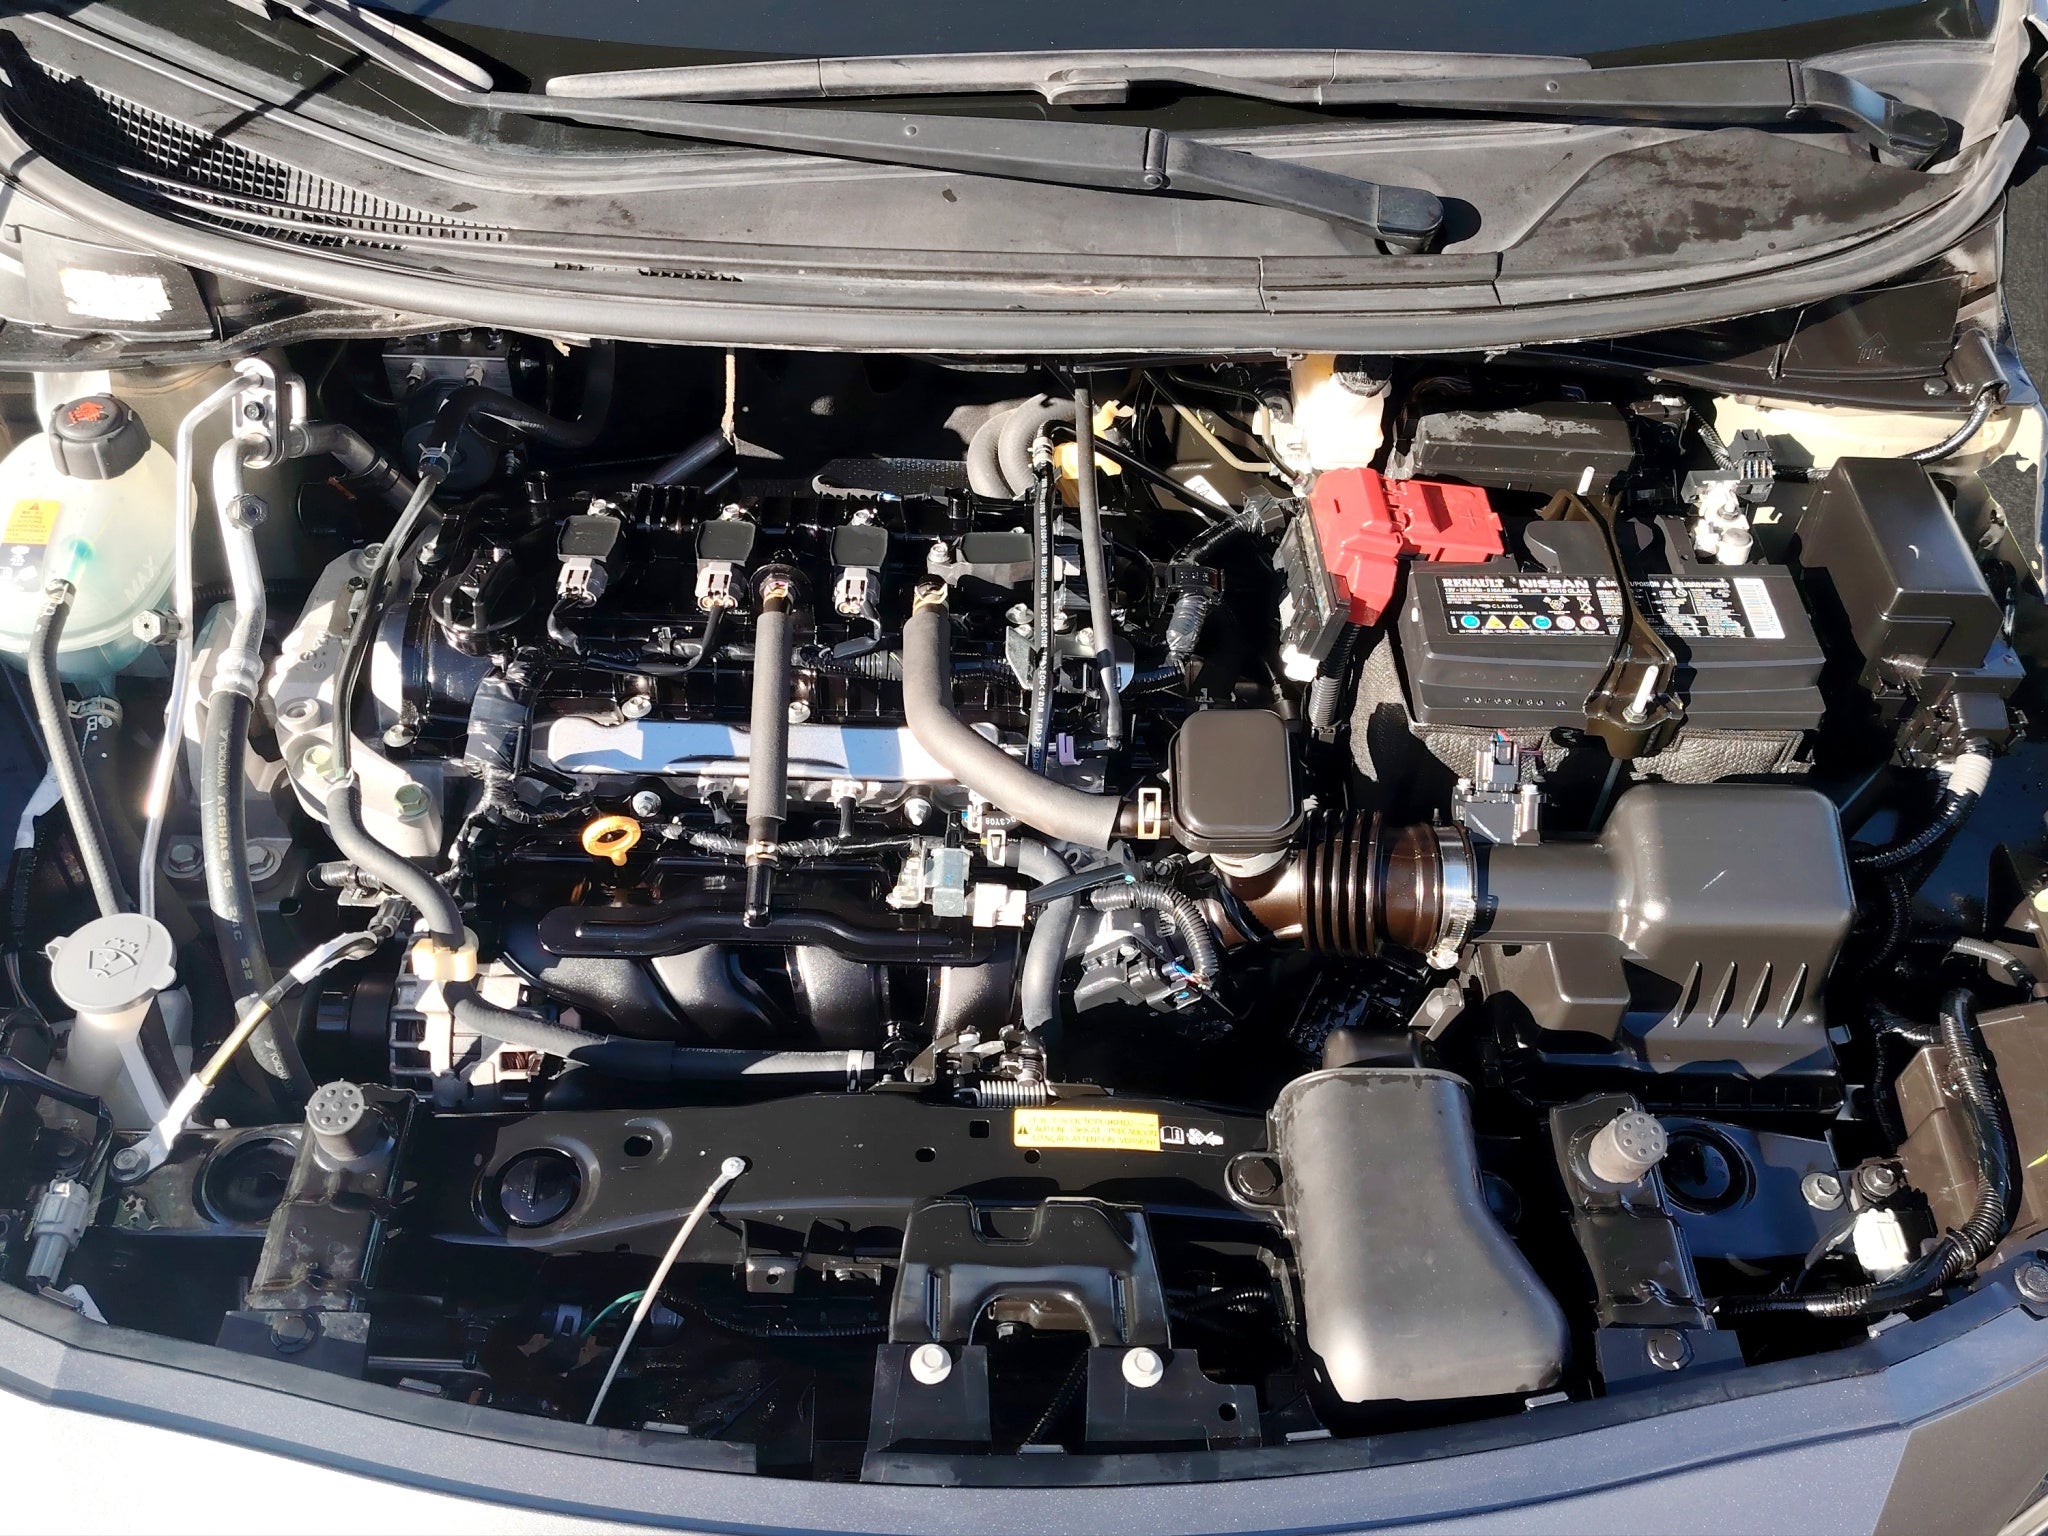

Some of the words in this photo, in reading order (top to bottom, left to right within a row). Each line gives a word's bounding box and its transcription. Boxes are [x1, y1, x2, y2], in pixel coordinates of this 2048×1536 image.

[1441, 578, 1505, 588] RENAULT
[1518, 578, 1590, 588] NISSAN
[216, 741, 229, 788] YOKOHAMA
[223, 868, 234, 889] 15
[229, 905, 243, 941] 24C
[240, 957, 254, 982] 22
